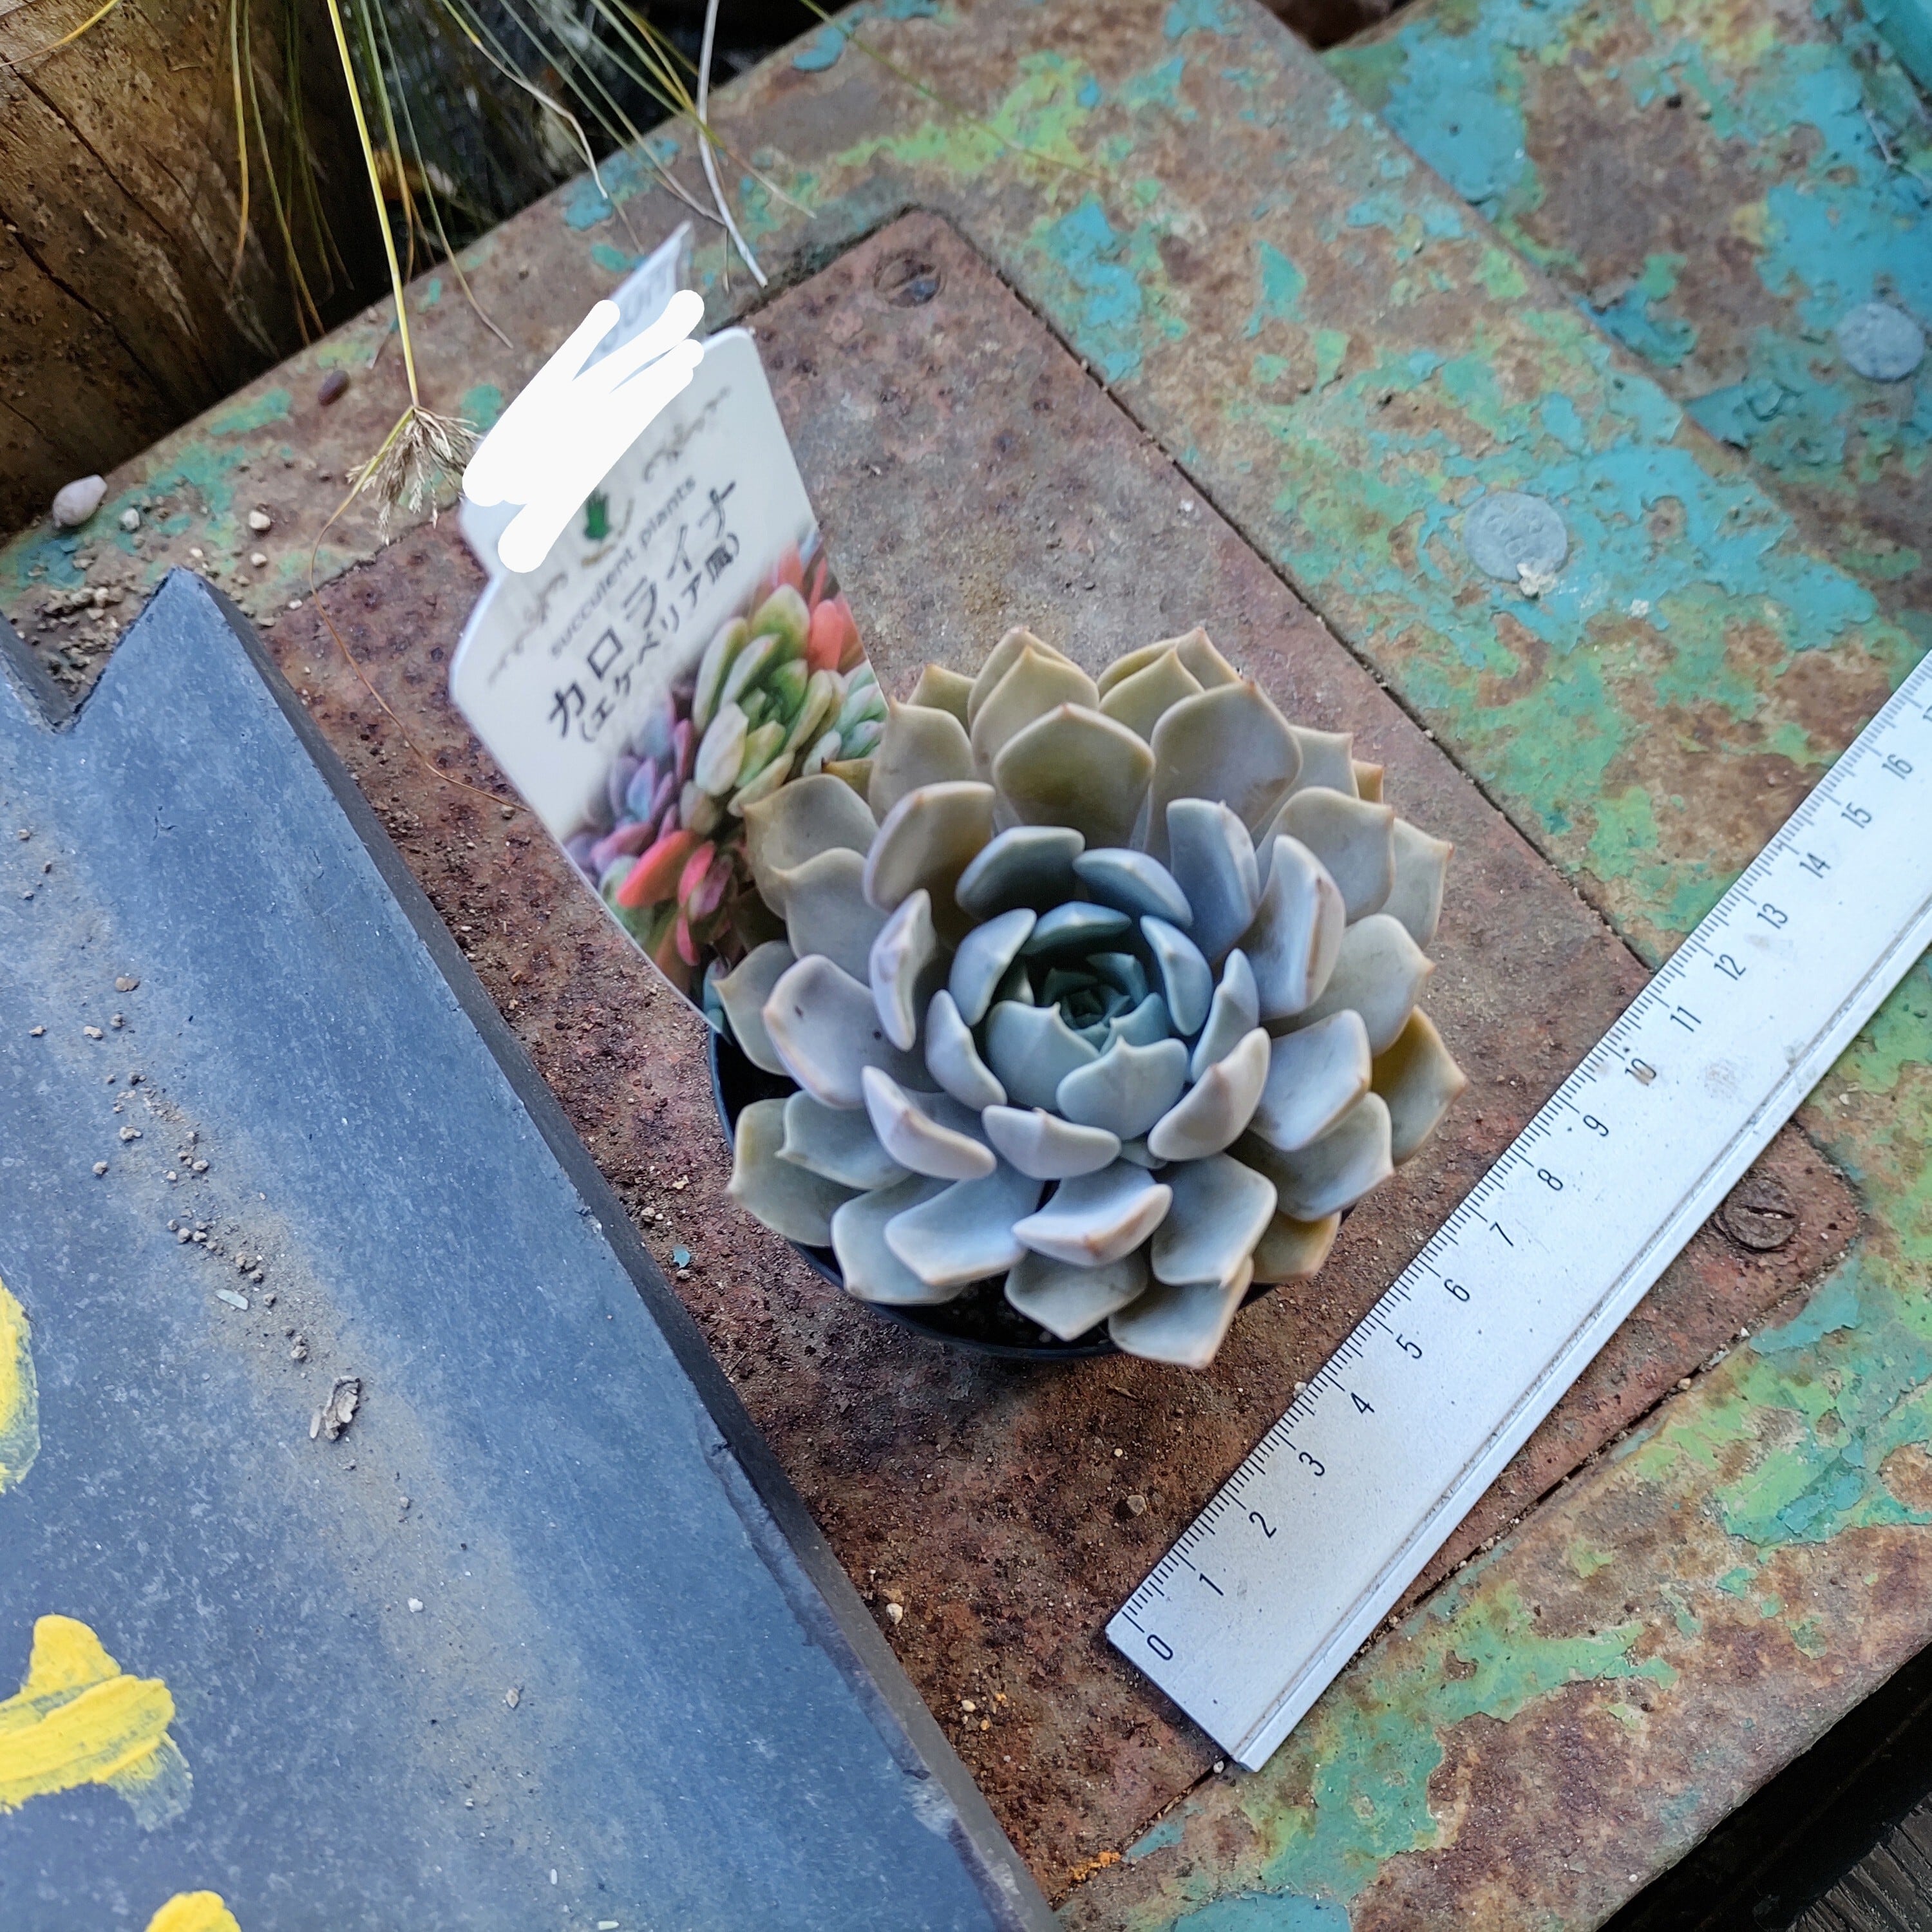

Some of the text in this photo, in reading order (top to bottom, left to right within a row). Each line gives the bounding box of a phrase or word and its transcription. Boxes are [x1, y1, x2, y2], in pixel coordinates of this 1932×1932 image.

[549, 480, 736, 739] カロライナ
[551, 475, 696, 658] succulent plants
[1146, 753, 1914, 1662] 0 1 2 3 4 5 6 7 8 9 10 11 12 13 14 15 16
